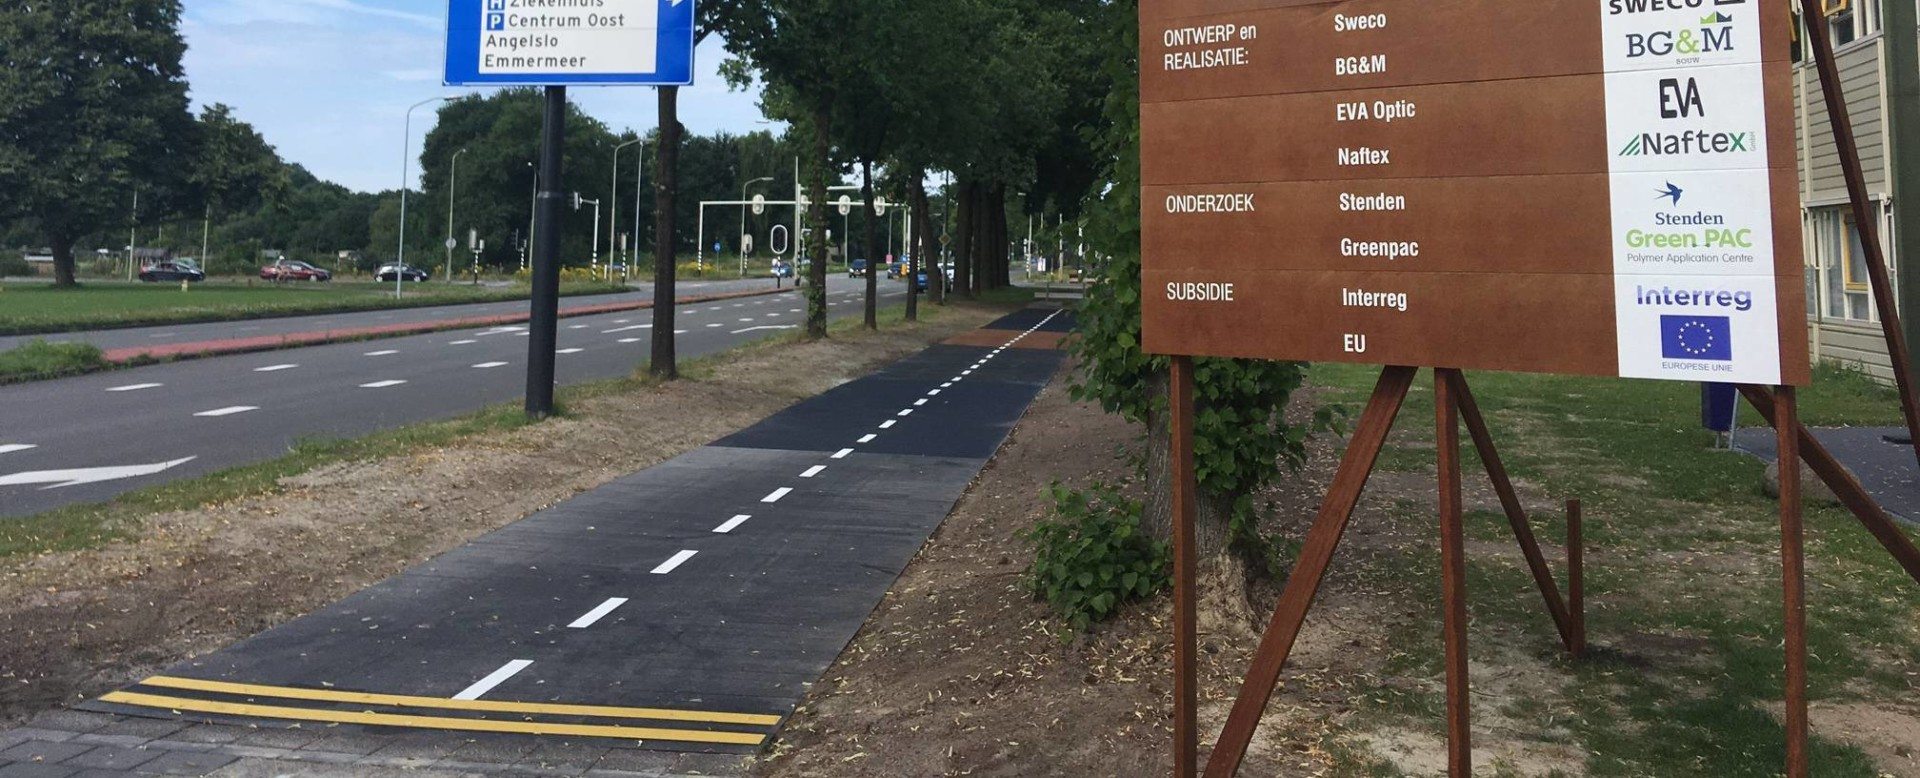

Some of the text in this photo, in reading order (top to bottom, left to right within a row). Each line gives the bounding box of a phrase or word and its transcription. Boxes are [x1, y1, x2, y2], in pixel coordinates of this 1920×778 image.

[508, 14, 581, 28] Centrum
[588, 13, 625, 27] Oost
[1334, 13, 1387, 32] Sweco
[486, 34, 558, 51] Angelslo
[1164, 24, 1257, 47] ONTWERP en
[1625, 26, 1734, 58] BG&M
[485, 54, 586, 68] Emmermeer
[1164, 48, 1249, 70] REALISATIE:
[1335, 55, 1386, 75] BG&M
[1676, 57, 1700, 65] BOUW
[1659, 77, 1705, 119] EVA
[1337, 100, 1416, 122] EVA Optic
[1642, 130, 1747, 155] Naftex
[1338, 148, 1390, 165] Naftex
[1166, 194, 1255, 213] ONDERZOEK
[1339, 193, 1406, 211] Stenden
[1655, 211, 1724, 226] Stenden
[1626, 228, 1753, 248] Green PAC
[1341, 238, 1419, 260] Greenpac
[1627, 253, 1754, 264] Polymer Application Centre
[1167, 282, 1234, 301] SUBSIDIE
[1342, 288, 1408, 312] Interreg
[1636, 285, 1752, 311] Interreg
[1344, 334, 1366, 353] EU
[1662, 361, 1733, 372] EUROPESE UNIE
